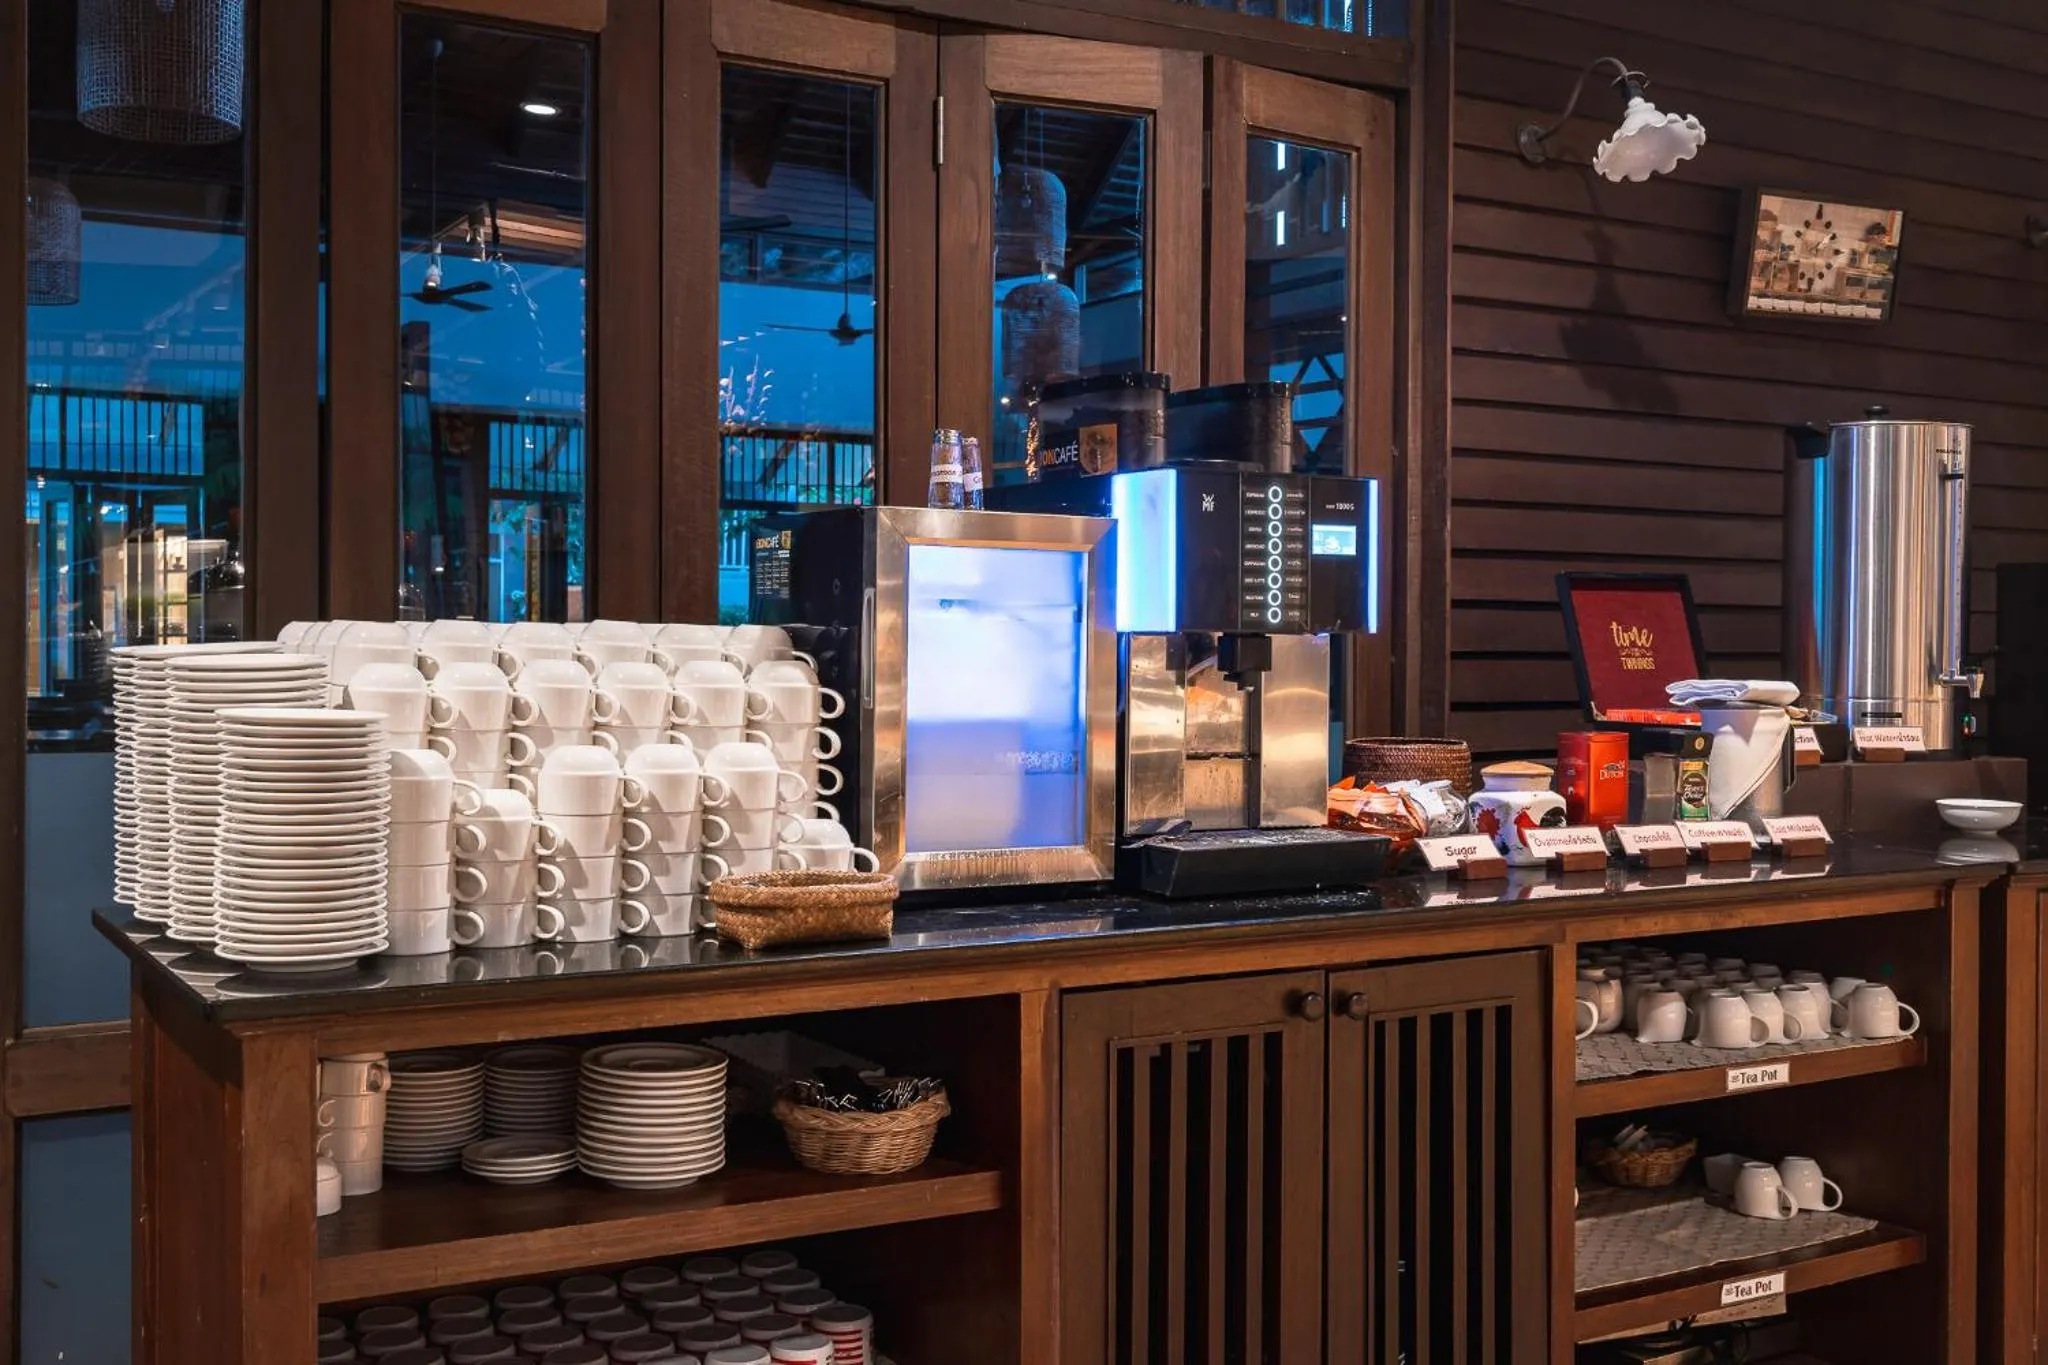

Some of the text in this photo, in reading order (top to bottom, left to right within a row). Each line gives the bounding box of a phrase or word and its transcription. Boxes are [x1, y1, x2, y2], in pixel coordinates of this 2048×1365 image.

[1444, 846, 1477, 860] Sugar
[1740, 1069, 1778, 1084] Tea Pot
[1734, 1280, 1772, 1298] Tea Pot
